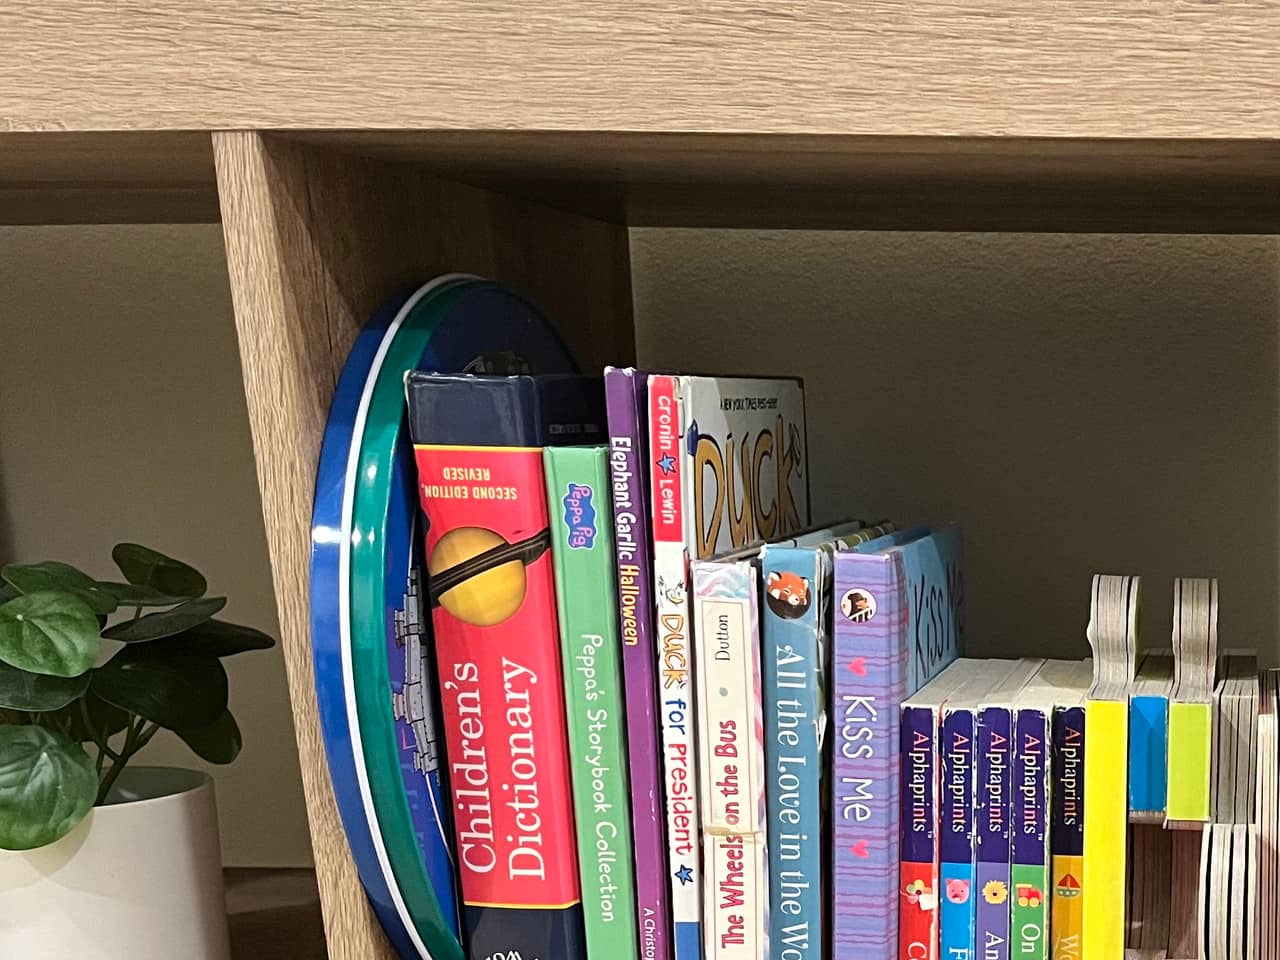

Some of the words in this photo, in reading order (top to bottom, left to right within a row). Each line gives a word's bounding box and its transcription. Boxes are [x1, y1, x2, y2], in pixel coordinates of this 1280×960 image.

[443, 467, 490, 481] REVISED
[473, 485, 518, 500] SECOND
[610, 436, 632, 508] Elephant
[565, 484, 591, 525] Peppa
[660, 479, 675, 525] Lewin
[570, 525, 594, 548] Pig
[616, 510, 637, 560] Garlic
[618, 563, 640, 646] Halloween
[715, 614, 731, 662] Dutton
[576, 634, 603, 702] Peppa's
[776, 645, 807, 690] All
[664, 698, 688, 736] for
[714, 719, 738, 759] Bus
[777, 699, 808, 746] the
[841, 695, 877, 760] Kiss
[444, 661, 497, 874] Children's
[502, 656, 546, 881] Dictionary
[585, 709, 610, 814] Storybook
[716, 764, 738, 796] the
[668, 743, 693, 856] President
[778, 755, 807, 825] Love
[841, 777, 873, 822] Me
[725, 801, 740, 825] on
[780, 833, 809, 861] in
[595, 822, 619, 922] Collection
[720, 832, 744, 909] Wheels
[780, 870, 810, 915] the
[643, 907, 651, 917] A
[721, 914, 745, 949] The
[1020, 923, 1041, 954] On
